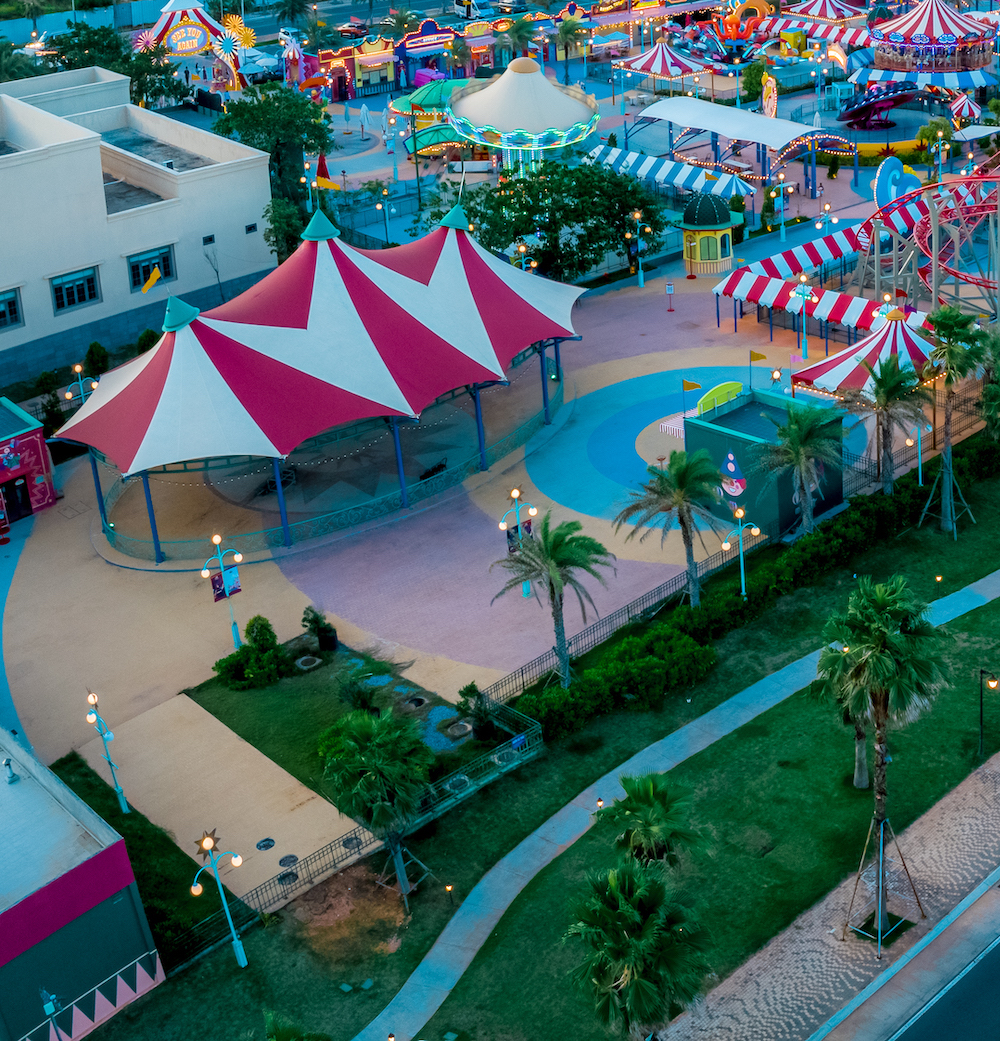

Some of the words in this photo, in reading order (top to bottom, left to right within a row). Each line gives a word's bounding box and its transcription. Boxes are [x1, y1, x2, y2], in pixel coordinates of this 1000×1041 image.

[171, 28, 187, 43] SEE
[187, 27, 202, 39] YOU
[177, 39, 198, 51] AGAIN
